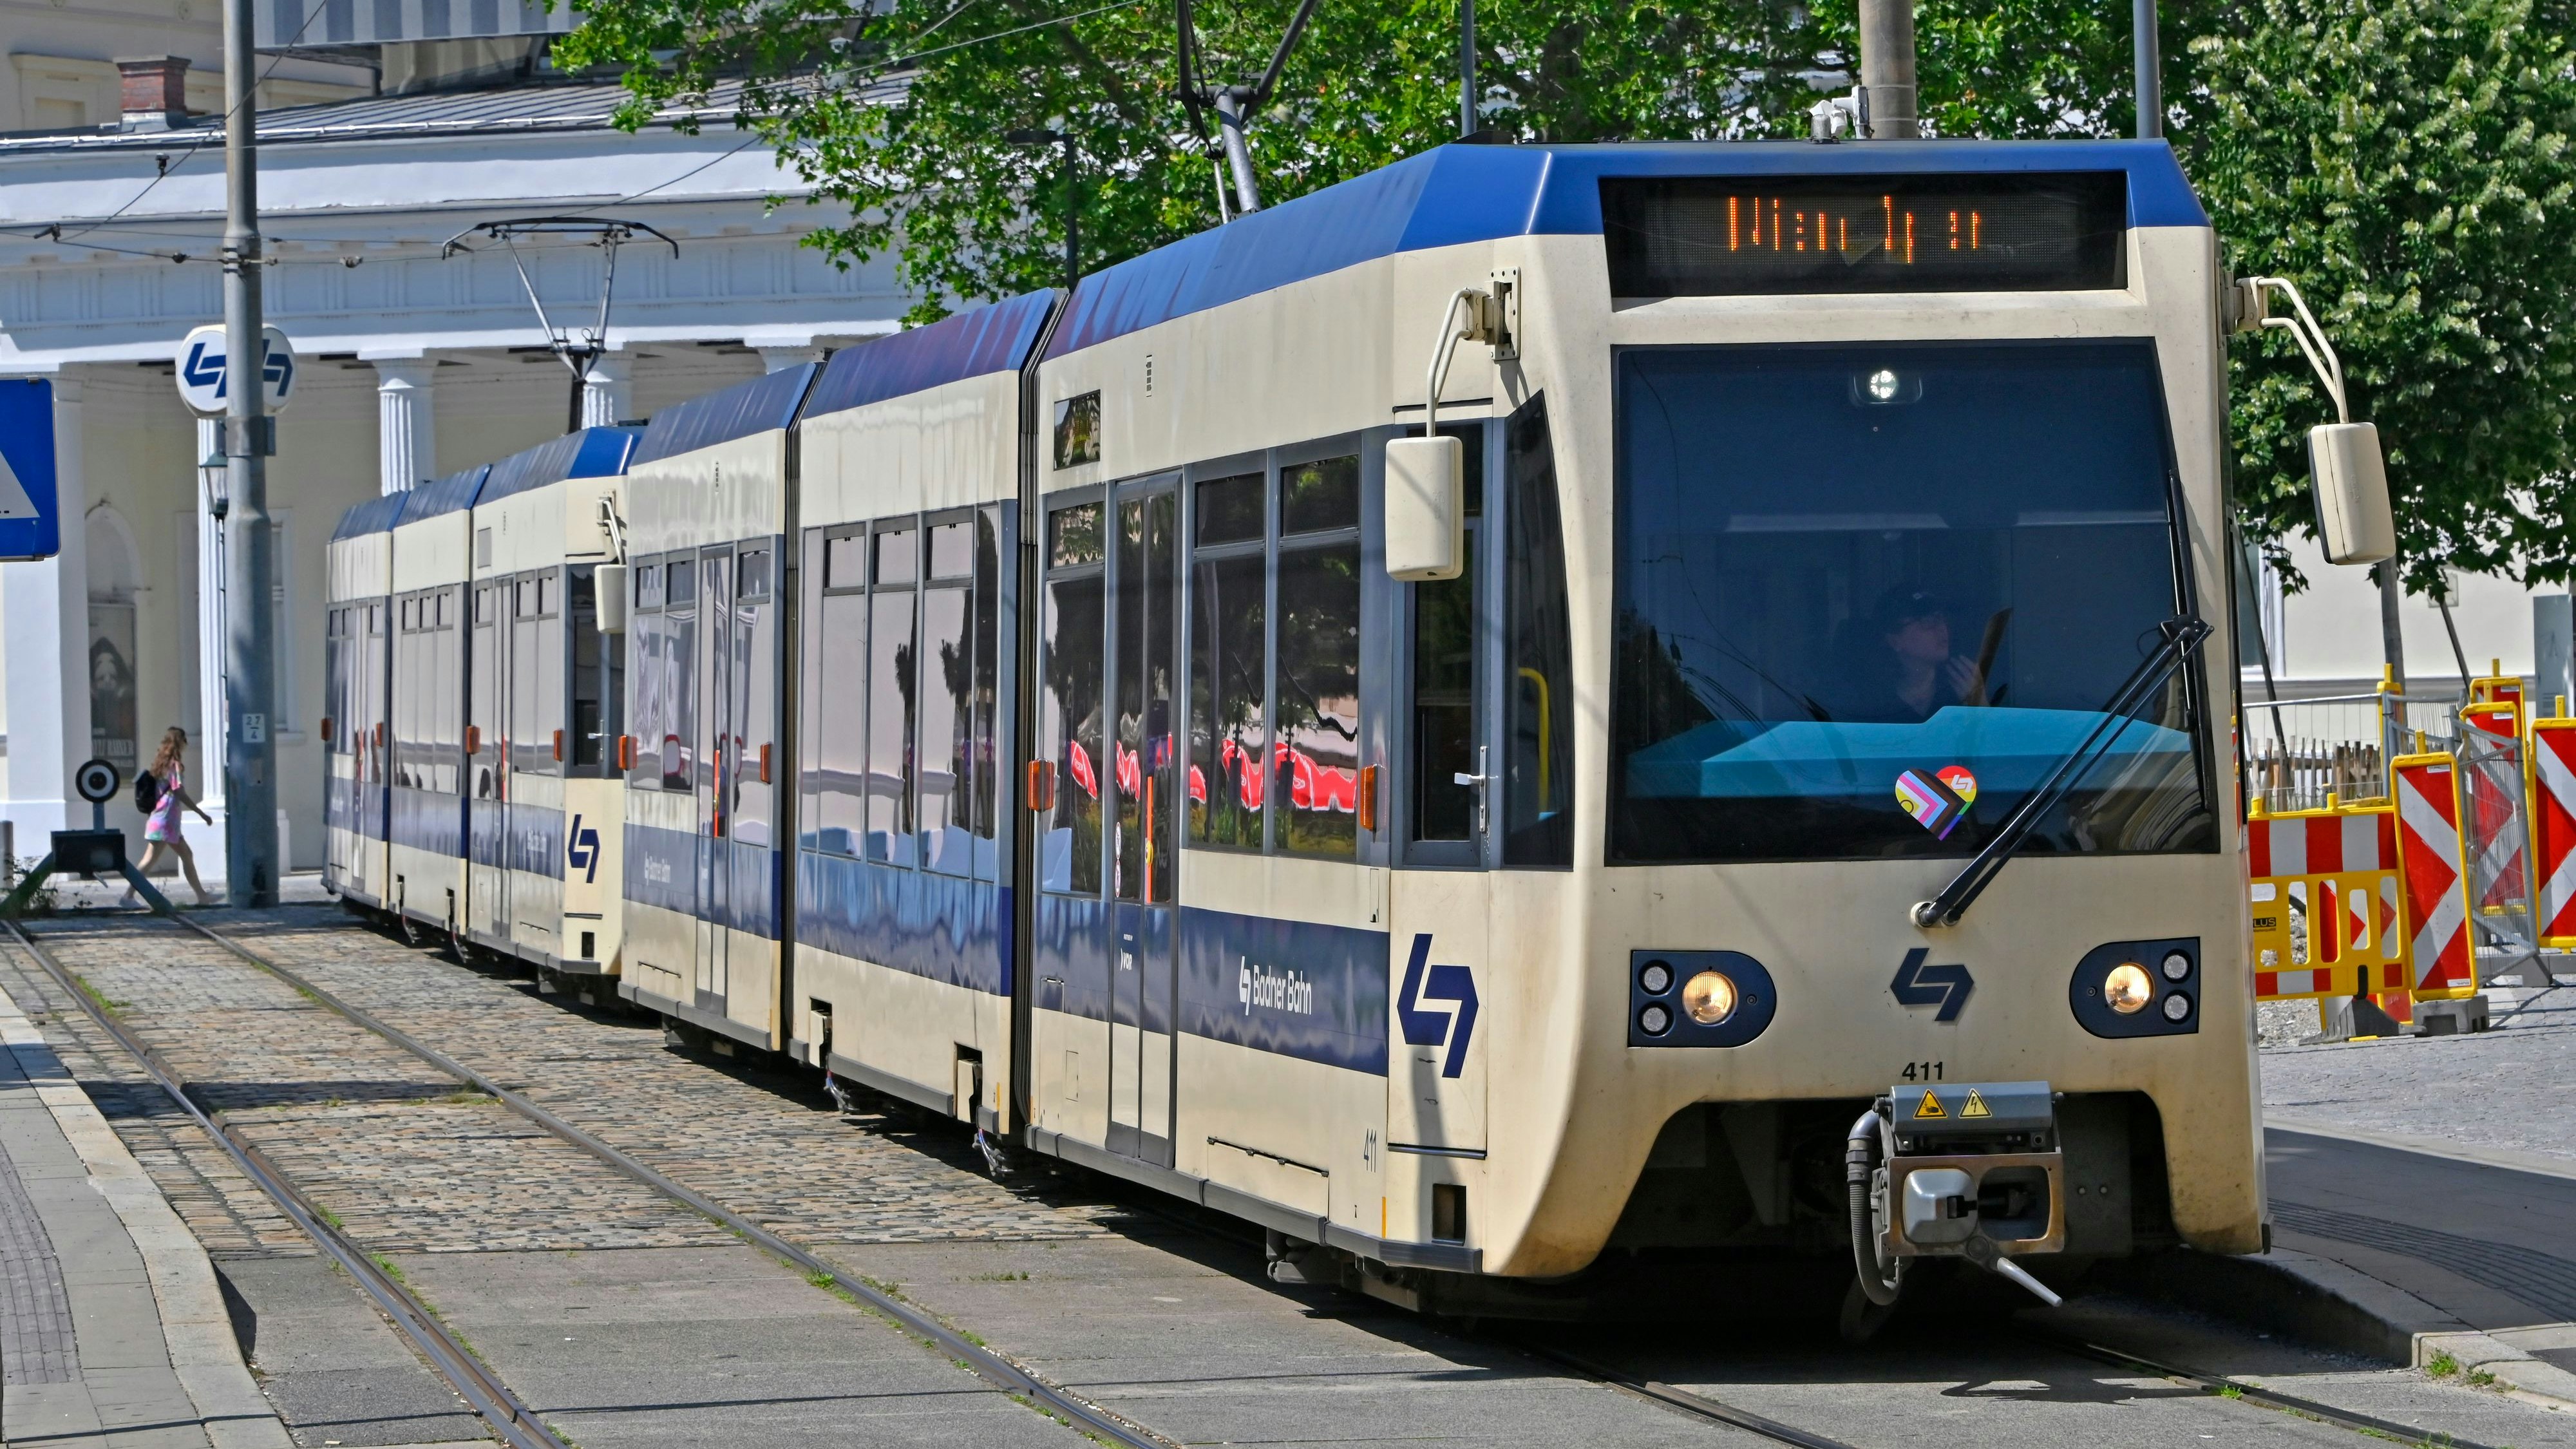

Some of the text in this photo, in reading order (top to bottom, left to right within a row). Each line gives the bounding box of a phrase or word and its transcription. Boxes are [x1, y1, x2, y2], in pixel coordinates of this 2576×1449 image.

[246, 715, 261, 726] 27
[251, 731, 258, 740] 4
[1253, 964, 1312, 1016] Badner Bahn
[1902, 1061, 1943, 1081] 411
[1363, 1128, 1377, 1173] 411
